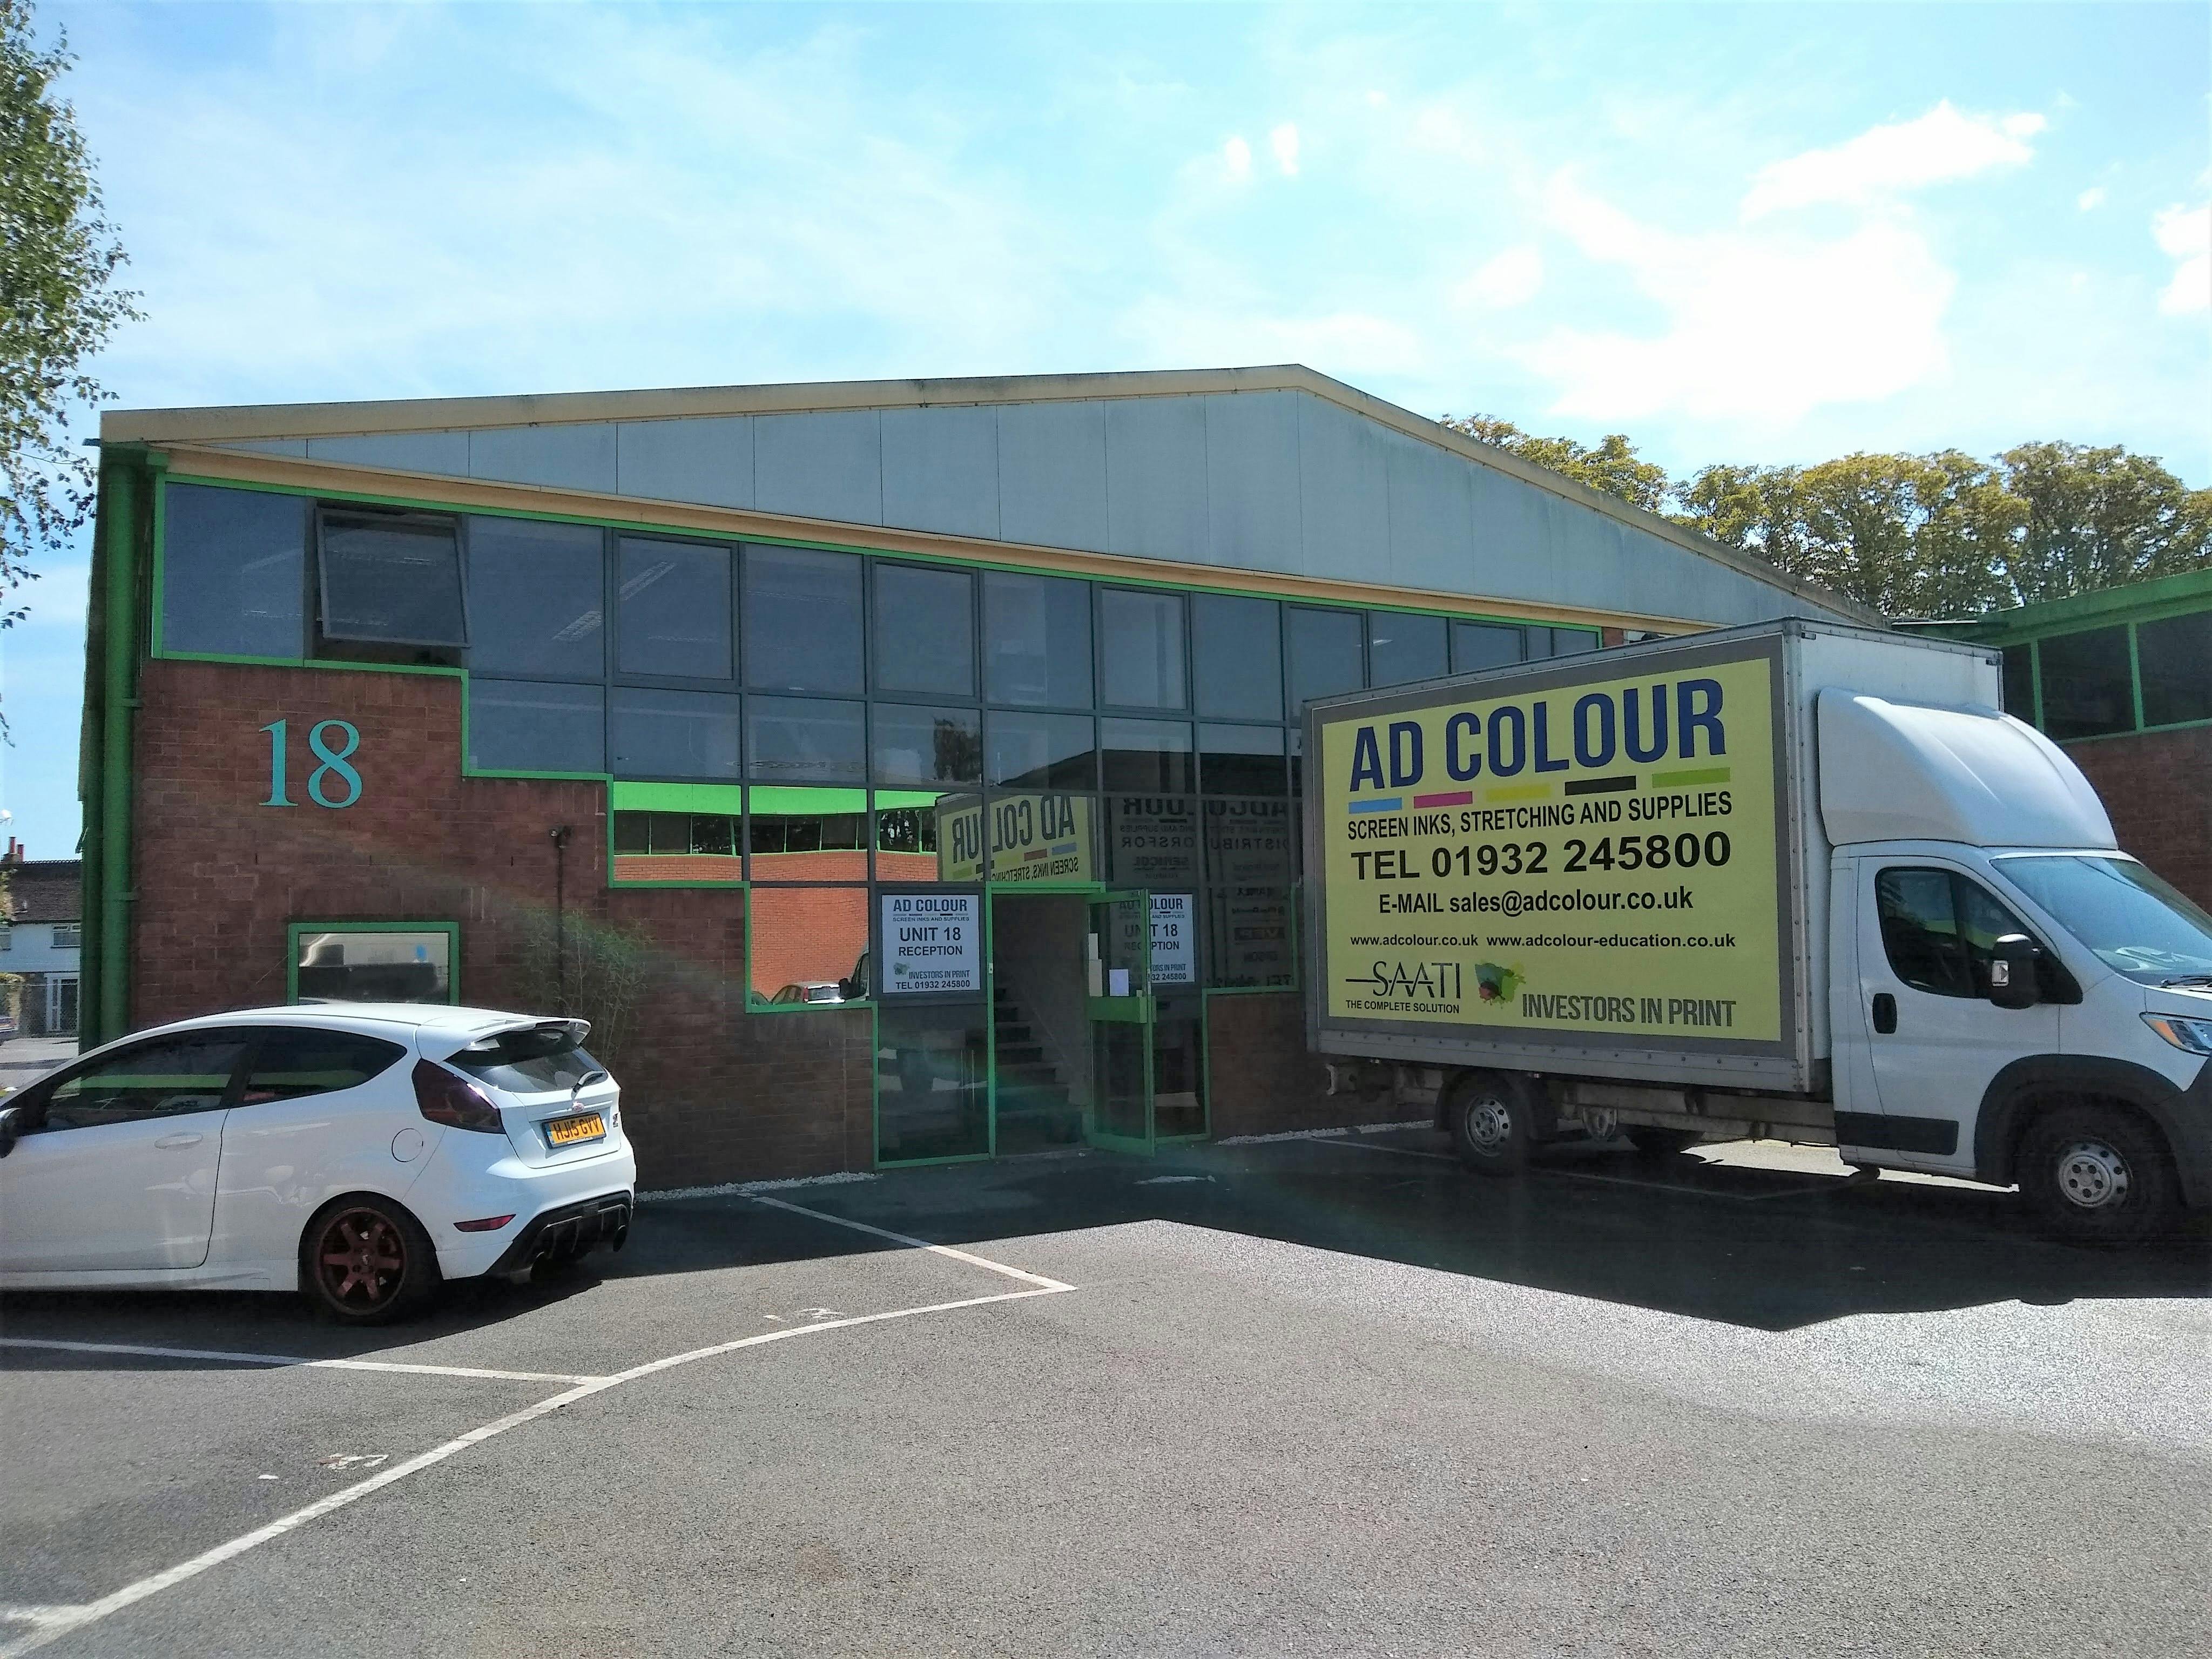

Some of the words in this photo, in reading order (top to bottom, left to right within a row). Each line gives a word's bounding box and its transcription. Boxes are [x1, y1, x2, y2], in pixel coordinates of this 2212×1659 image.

[1350, 721, 1423, 792] AD
[1446, 678, 1727, 781] COLOUR
[259, 718, 363, 809] 18
[1348, 817, 1408, 840] SCREEN
[1413, 815, 1456, 837] INKS,
[1460, 804, 1575, 833] STRETCHING
[1580, 801, 1621, 824] AND
[1628, 792, 1732, 822] SUPPLIES
[1351, 850, 1420, 880] TEL
[1432, 841, 1548, 878] 01932
[1564, 831, 1731, 872] 245800
[893, 899, 912, 912] AD
[916, 899, 967, 912] COLOUR
[1379, 893, 1444, 914] E-MAIL
[1449, 886, 1693, 917] sales@adcolour.co.uk
[900, 927, 938, 942] UNIT
[943, 927, 961, 941] 18
[1163, 924, 1178, 936] 18
[1351, 935, 1479, 947] www.adcolour.co.uk
[1487, 933, 1736, 948] www.adcolour-education.co.uk
[898, 946, 963, 956] RECEPTION
[909, 970, 942, 980] INVESTORS
[943, 970, 950, 979] IN
[952, 970, 970, 978] PRINT
[1372, 961, 1461, 999] SAATI
[941, 980, 970, 988] 245800
[1346, 1000, 1361, 1010] THE
[1364, 1000, 1411, 1012] COMPLETE
[1413, 1001, 1460, 1013] SOLUTION
[1522, 994, 1636, 1024] INVESTORS
[1641, 997, 1664, 1024] IN
[1669, 999, 1737, 1027] PRINT
